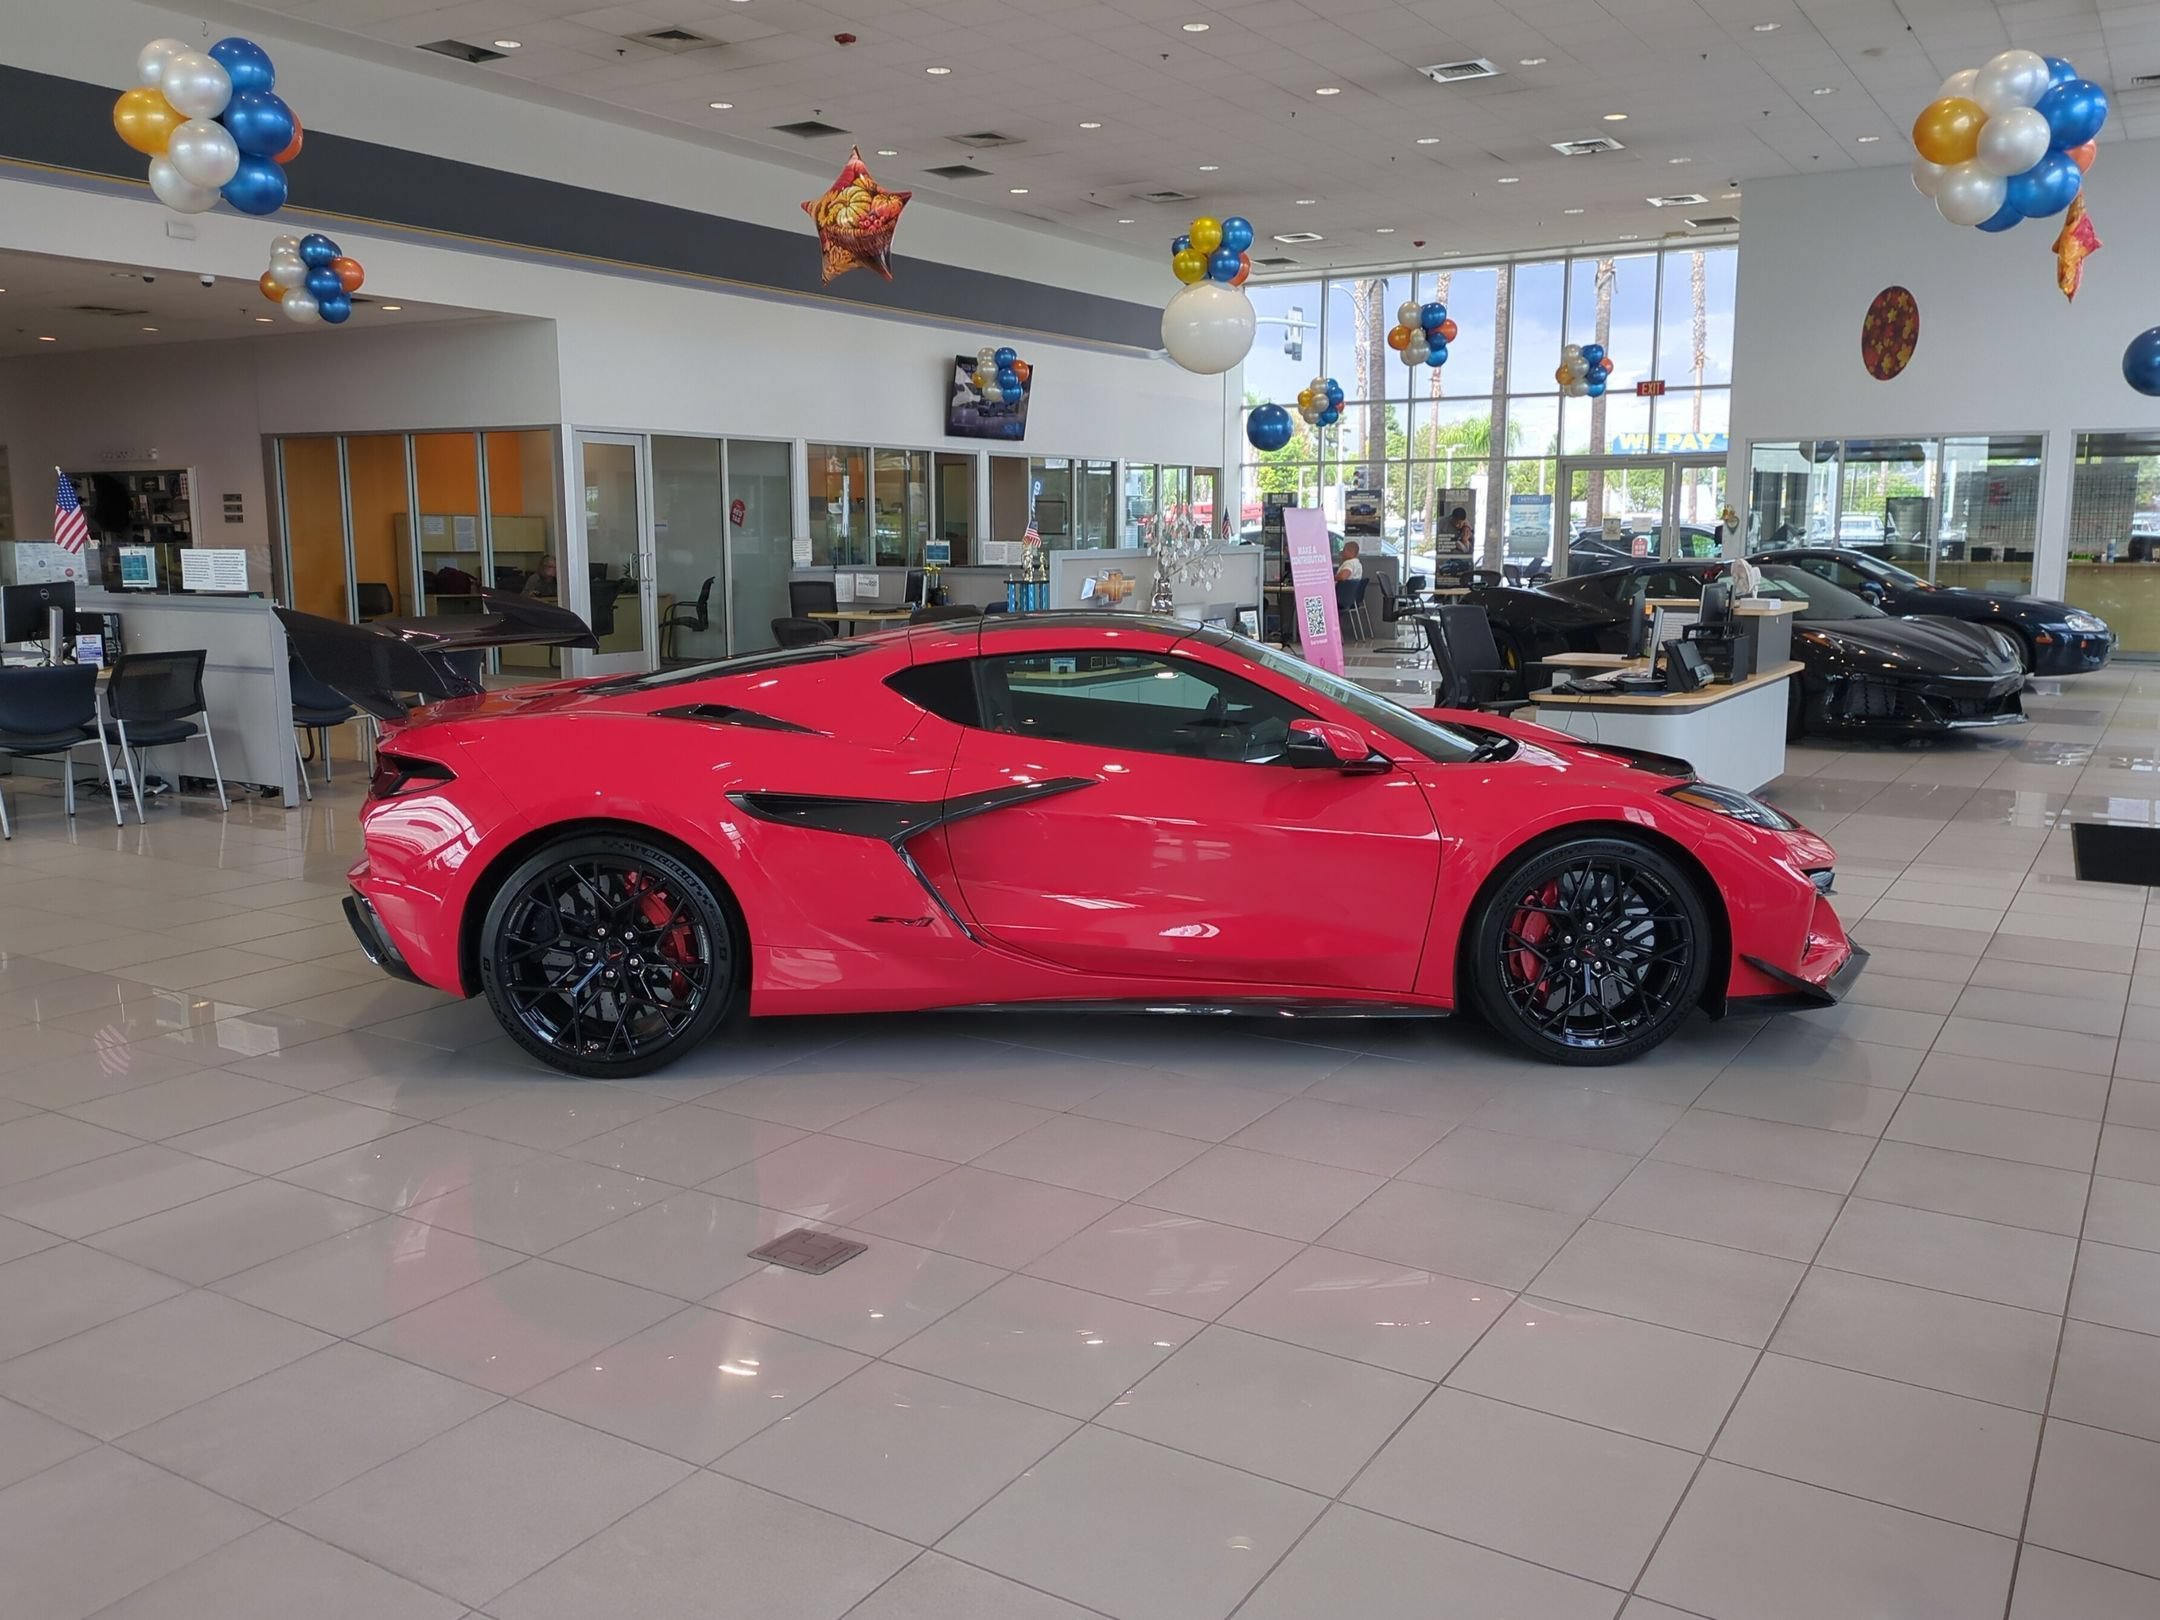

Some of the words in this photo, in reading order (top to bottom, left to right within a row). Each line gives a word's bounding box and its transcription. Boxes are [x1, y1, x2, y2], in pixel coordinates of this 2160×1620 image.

[1641, 382, 1661, 395] EXIT
[1619, 432, 1659, 450] WE
[1665, 431, 1715, 450] PAY
[644, 849, 697, 887] MICHELIN
